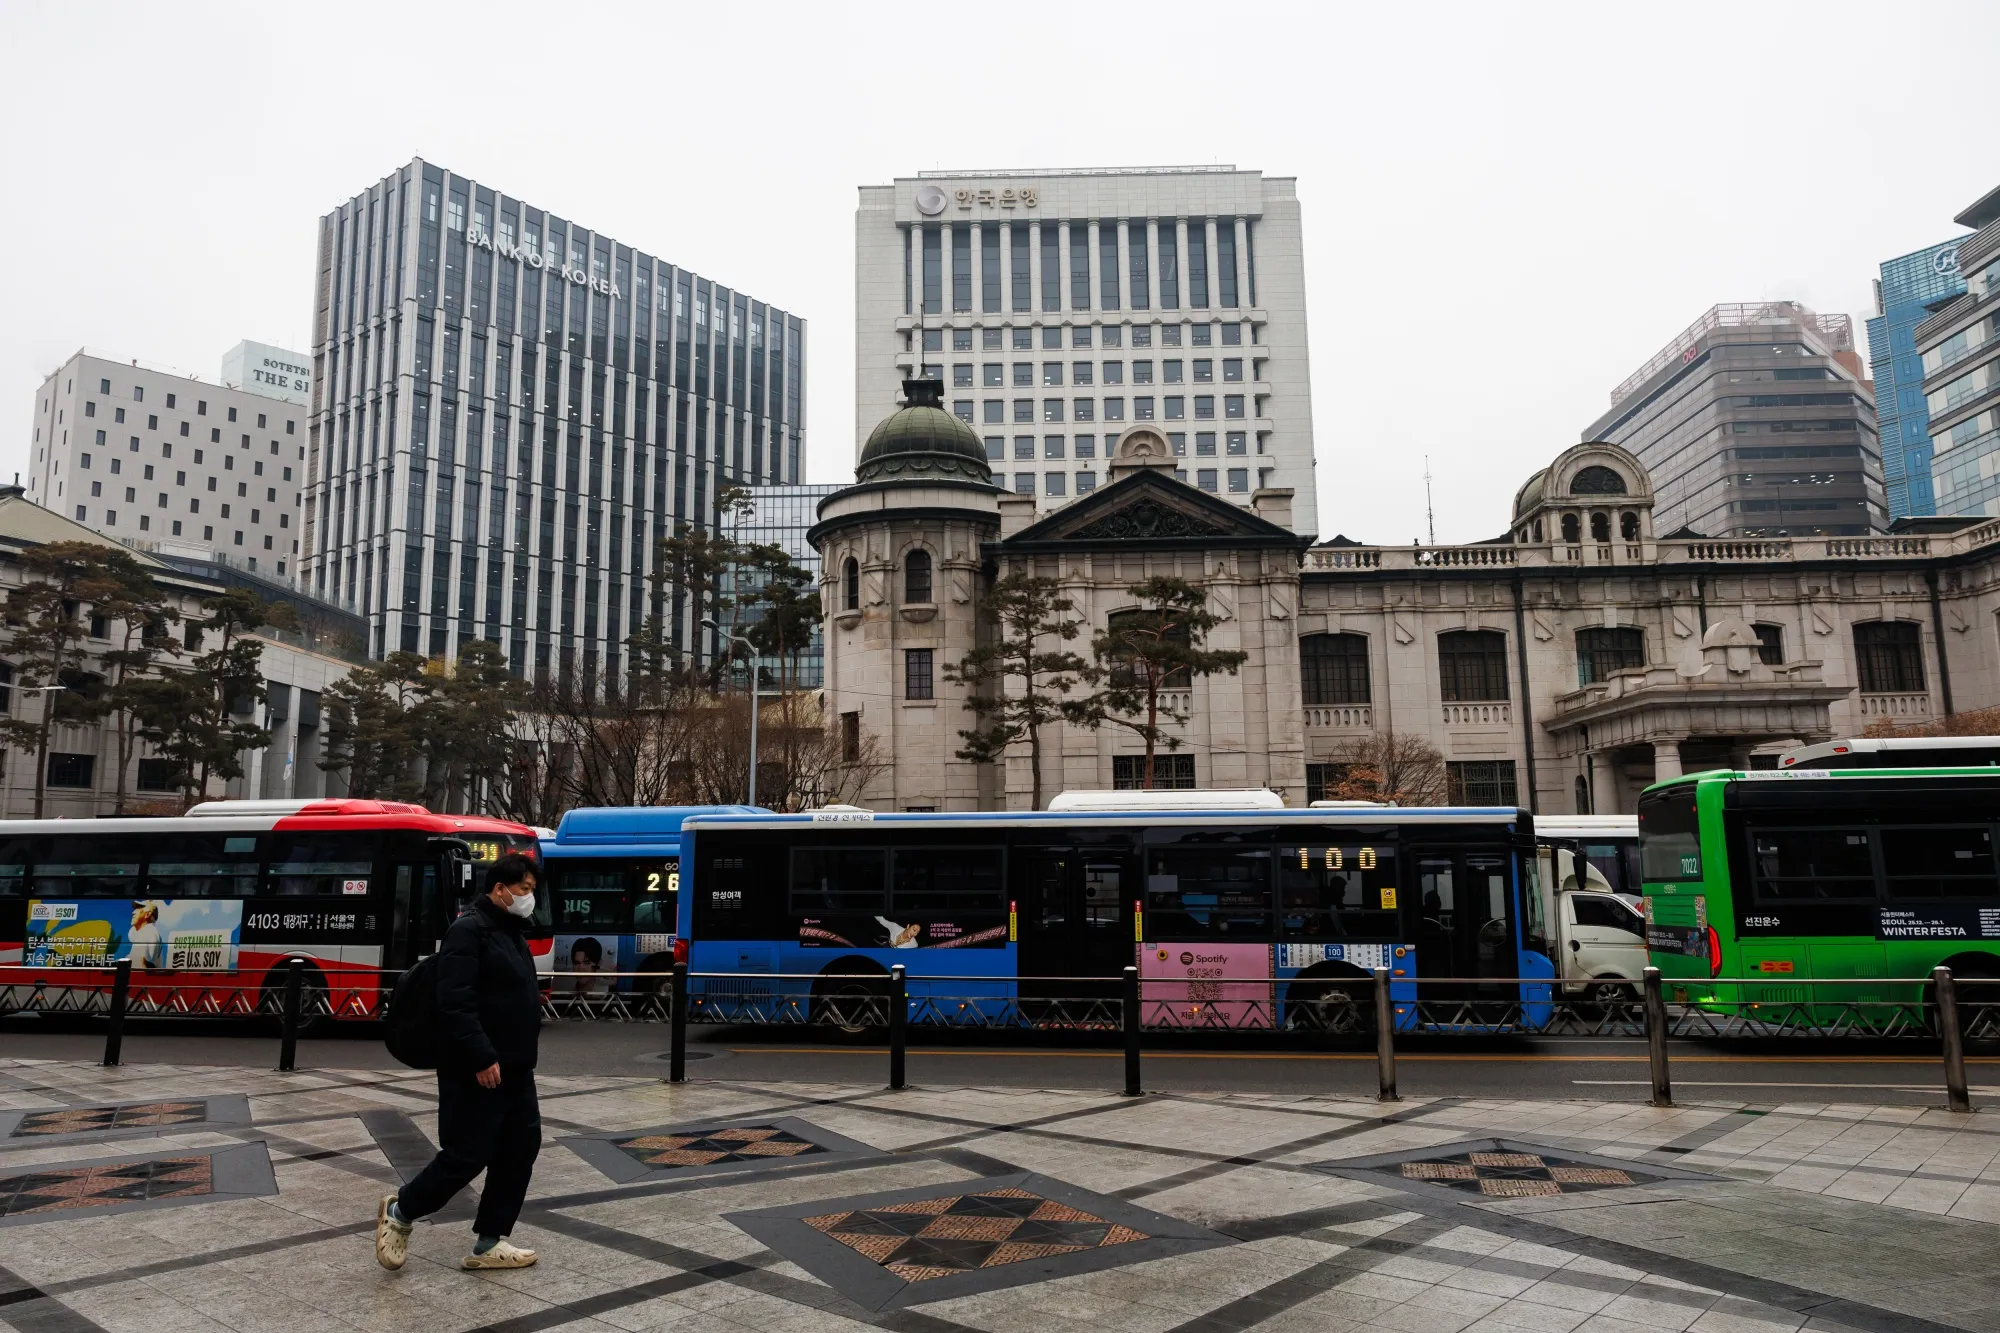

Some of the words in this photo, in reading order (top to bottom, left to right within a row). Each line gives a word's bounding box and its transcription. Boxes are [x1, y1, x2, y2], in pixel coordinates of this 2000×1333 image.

[955, 187, 1037, 210] 한국은행
[466, 227, 523, 263] BANK
[528, 252, 555, 272] OF
[561, 263, 622, 300] KOREA
[252, 368, 288, 388] THE
[1299, 847, 1377, 869] 100
[1681, 857, 1698, 874] 7022
[712, 891, 742, 900] 한성여객
[63, 907, 76, 918] SOY
[329, 914, 356, 922] 서울역
[247, 913, 280, 929] 4103
[283, 913, 309, 929] 대장지구
[1744, 916, 1781, 927] 선진운수
[1882, 927, 1929, 936] WINTER
[1930, 927, 1967, 936] FESTA
[27, 936, 84, 950] 탄소발자국이
[88, 936, 108, 950] 적은
[173, 934, 223, 950] SUSTAINABLE
[1195, 954, 1228, 964] Spotify
[1328, 948, 1341, 956] 100
[25, 953, 75, 967] 지속가능한
[76, 953, 116, 966] 미국대두
[186, 951, 202, 968] U.S.
[1180, 1011, 1195, 1020] 지금
